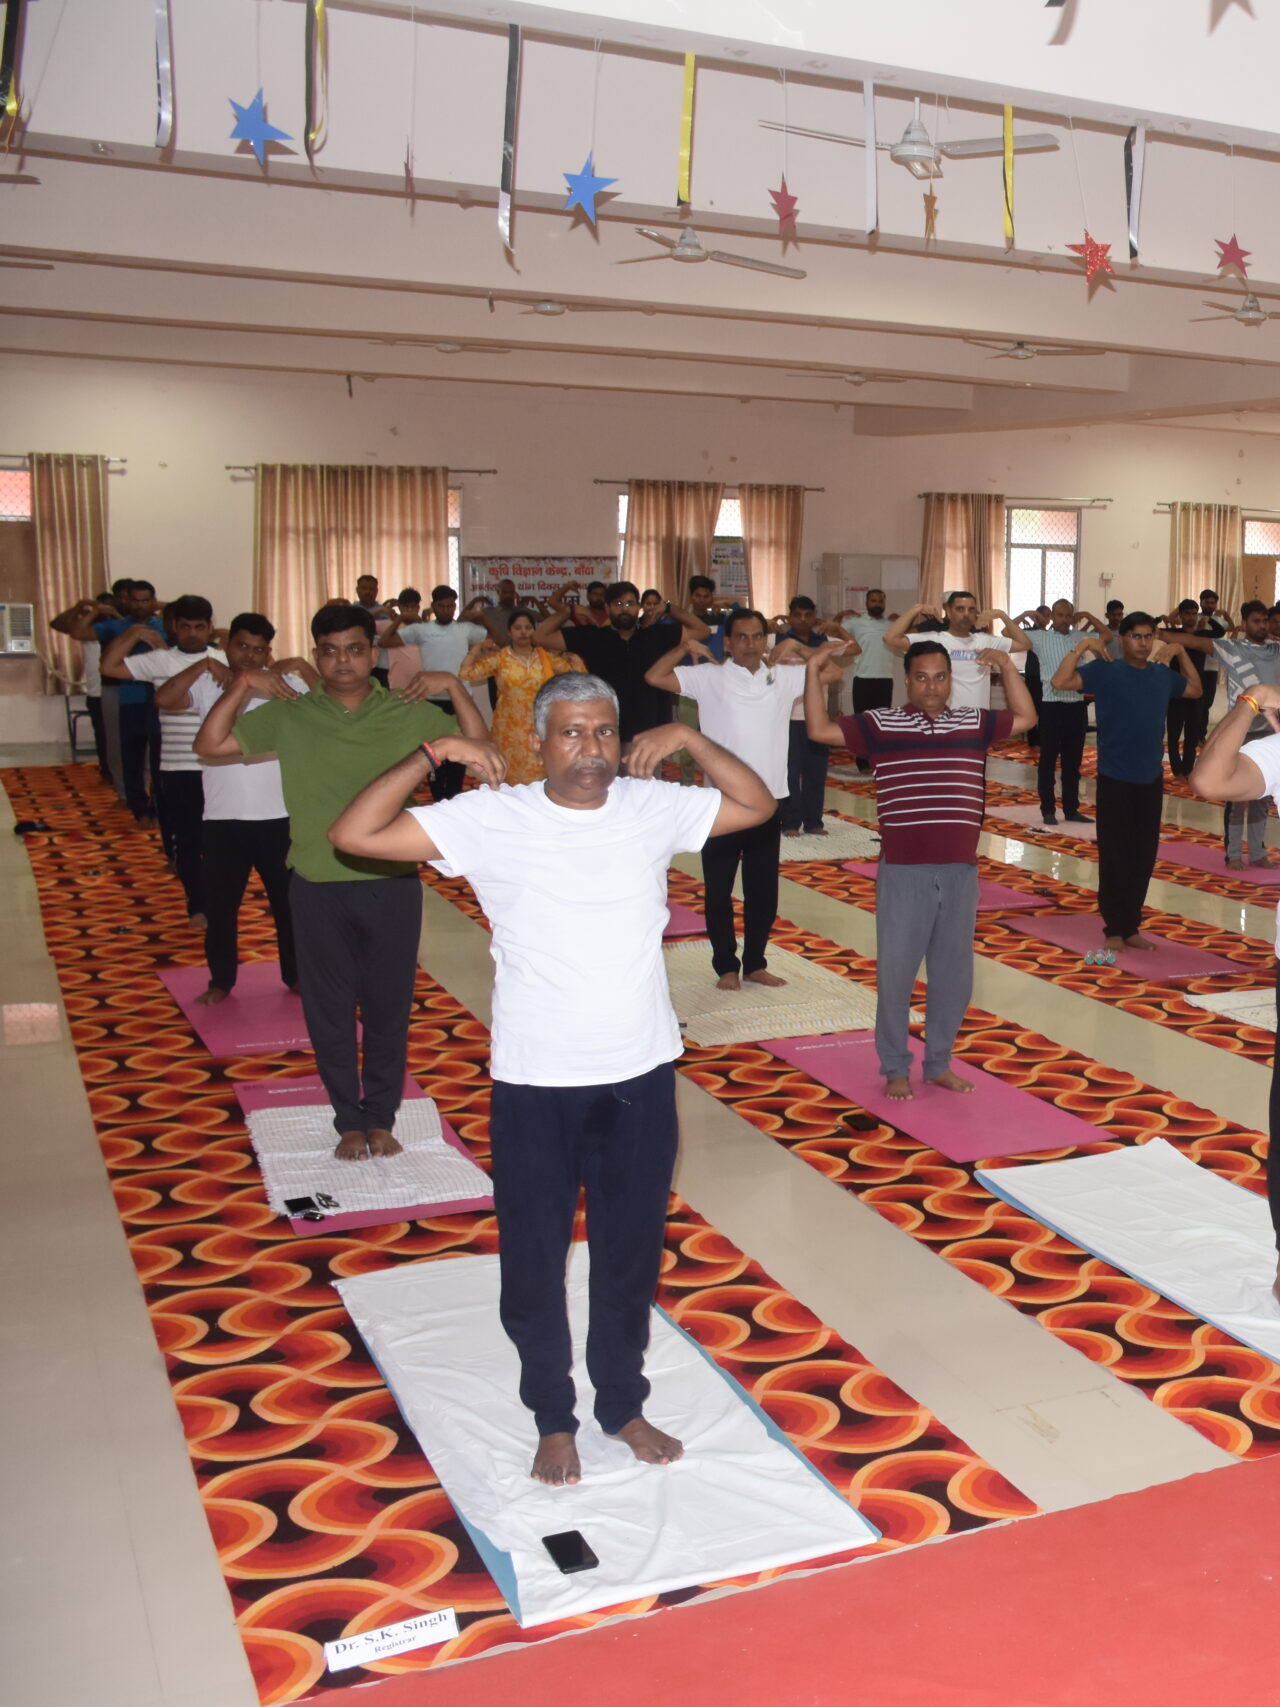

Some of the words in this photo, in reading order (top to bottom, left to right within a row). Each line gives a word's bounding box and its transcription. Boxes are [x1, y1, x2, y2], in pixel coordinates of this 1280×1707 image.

[488, 563, 509, 580] कृषि
[334, 1642, 359, 1654] Dr.
[364, 1630, 398, 1644] S.K.
[403, 1612, 448, 1633] Singh
[374, 1635, 417, 1654] Registrar
